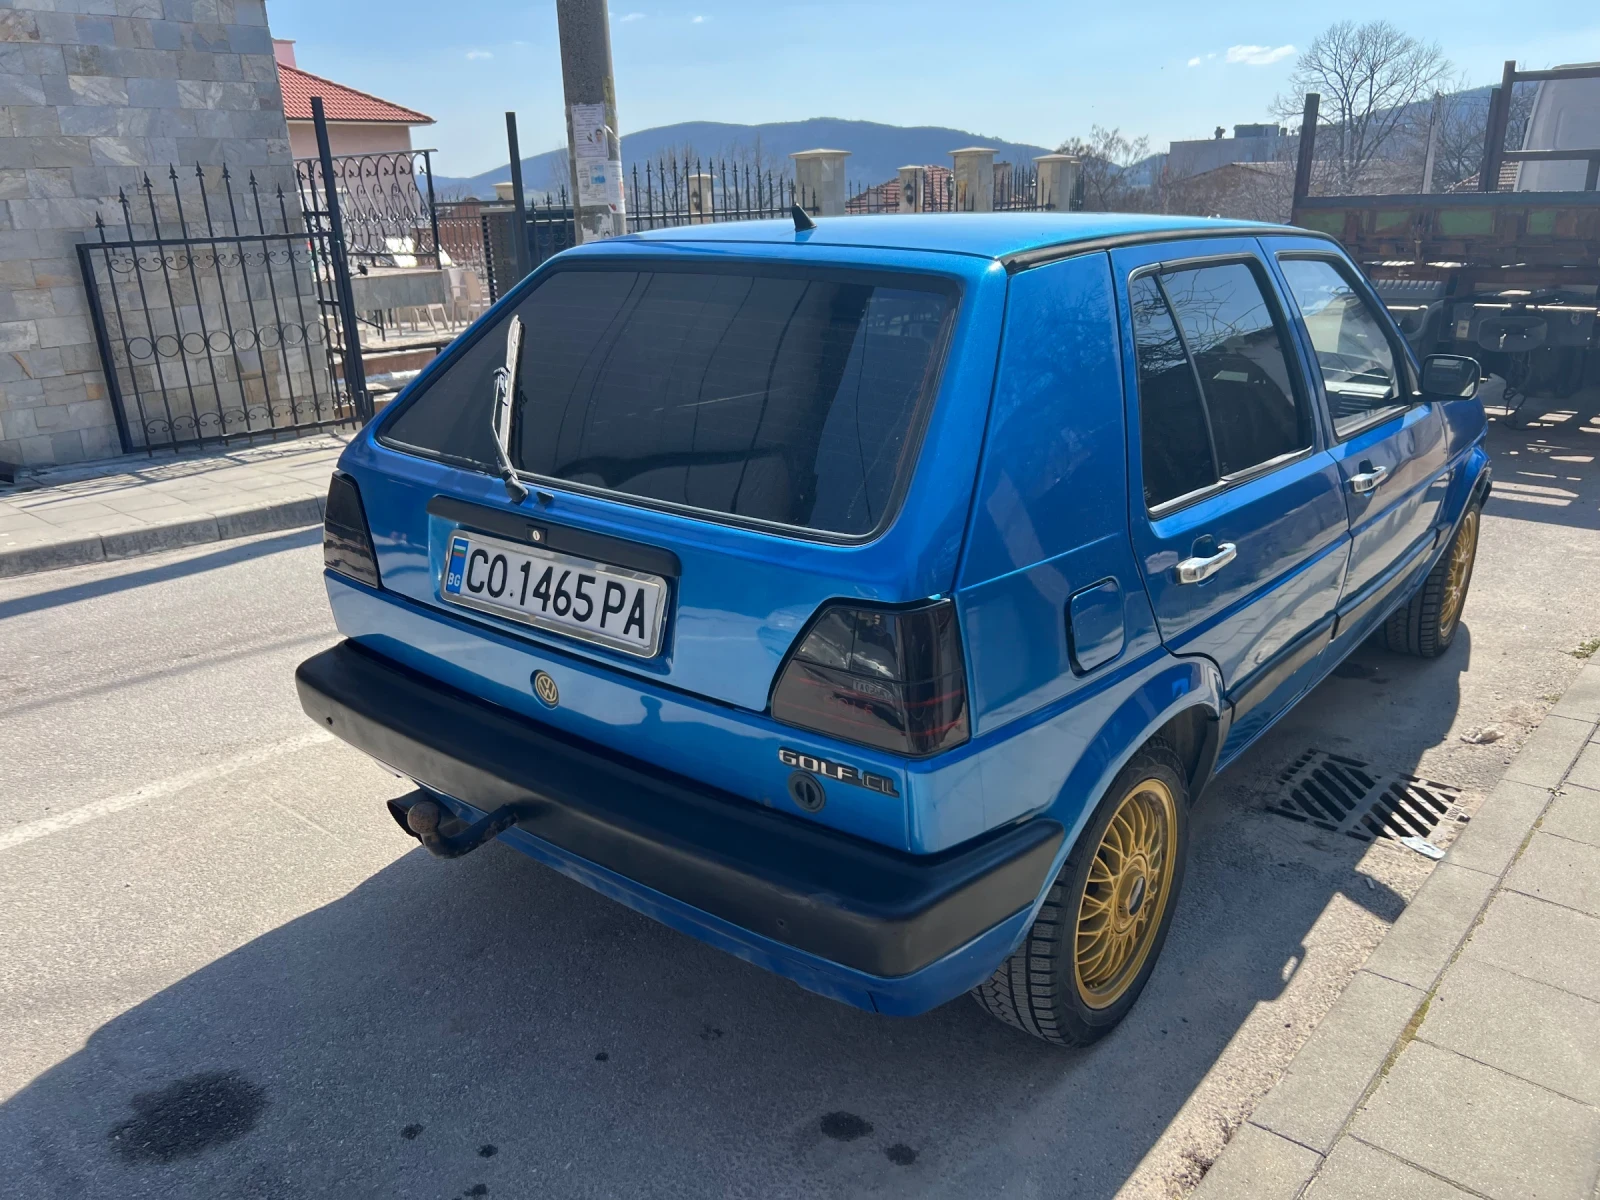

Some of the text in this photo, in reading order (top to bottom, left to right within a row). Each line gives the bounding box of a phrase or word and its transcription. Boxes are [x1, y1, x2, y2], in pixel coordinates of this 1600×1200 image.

[448, 572, 461, 587] BG
[536, 673, 558, 704] VW
[778, 748, 854, 781] GOLF
